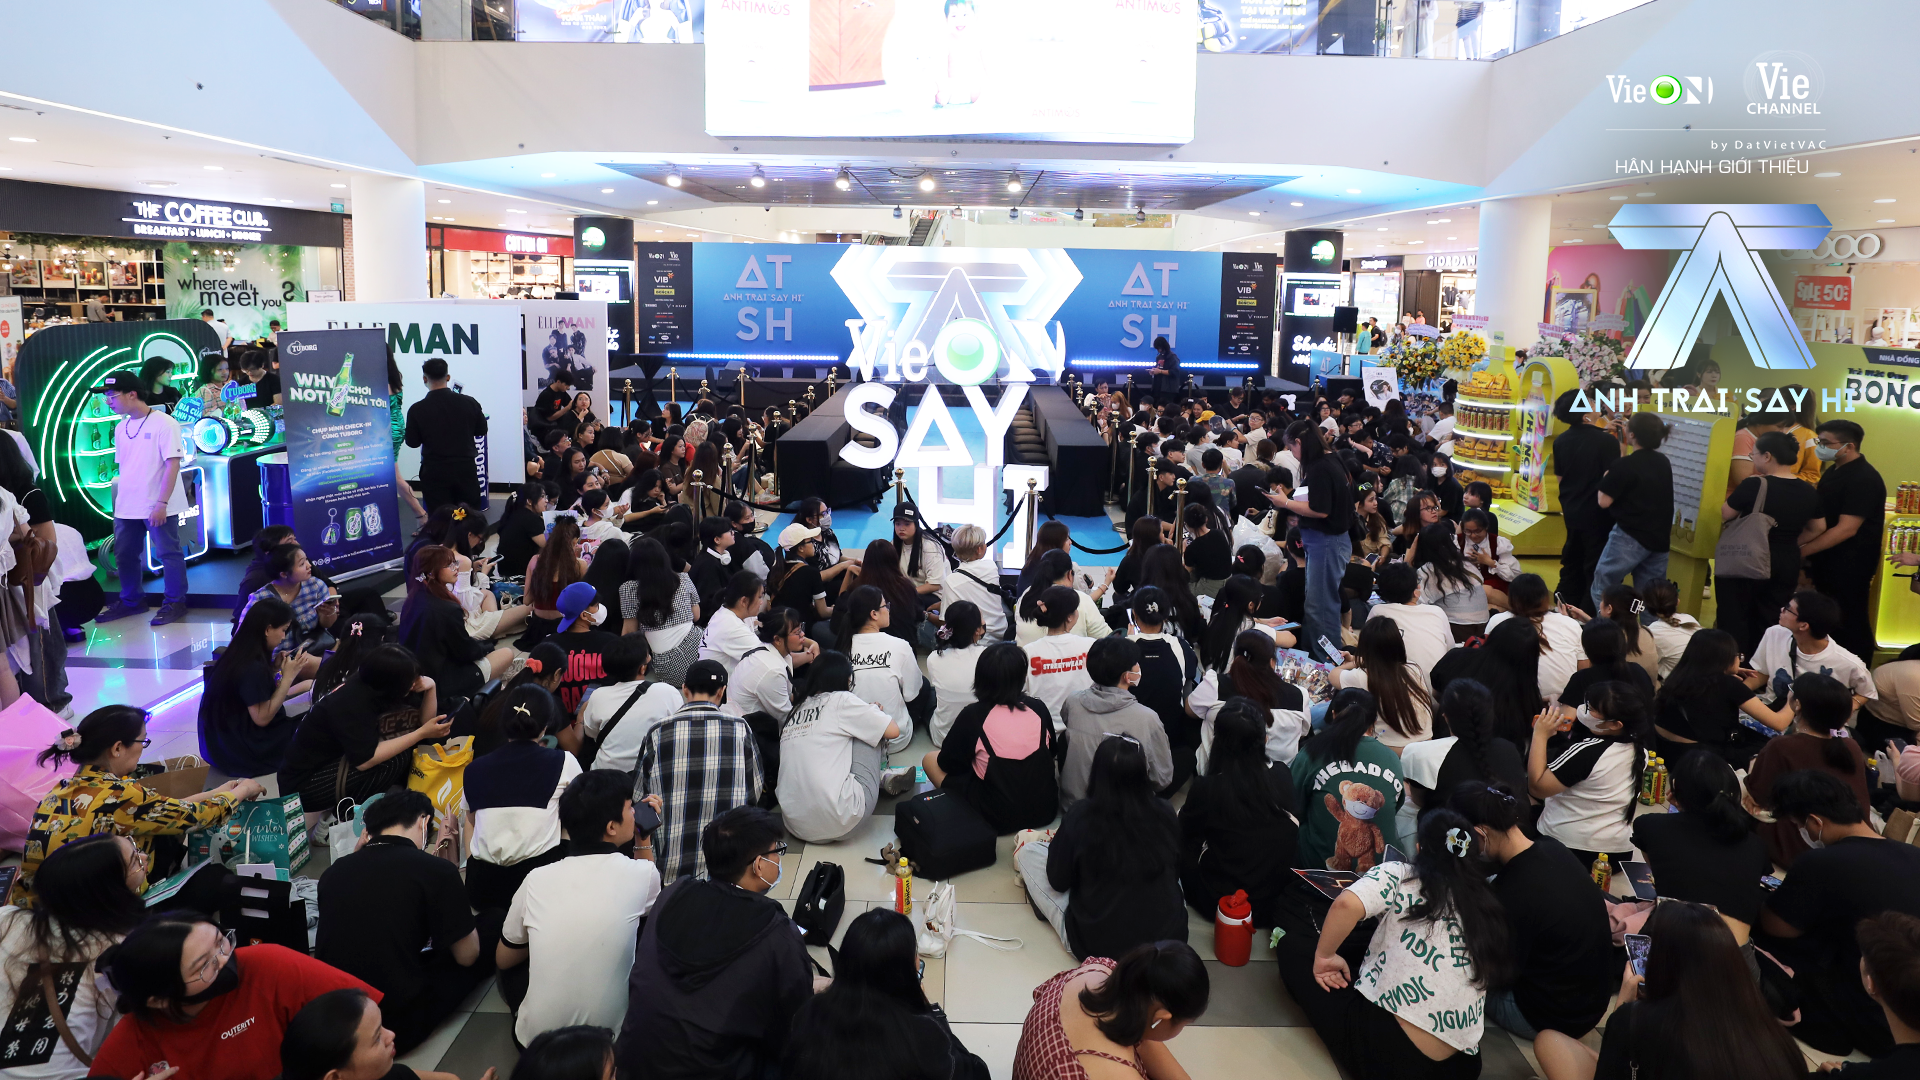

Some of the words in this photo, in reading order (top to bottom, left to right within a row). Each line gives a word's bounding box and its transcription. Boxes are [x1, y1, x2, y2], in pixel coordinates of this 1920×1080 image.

[133, 201, 162, 218] THE
[164, 202, 232, 226] COFFEE
[134, 224, 190, 237] BREAKFAST
[196, 228, 226, 239] LUNCH
[232, 231, 262, 241] DINNER
[177, 272, 228, 291] where
[230, 280, 248, 291] will
[200, 287, 259, 306] meet
[262, 299, 282, 311] you
[723, 292, 742, 300] ANH
[745, 293, 766, 301] TRAI
[1130, 300, 1152, 308] TRAI
[736, 306, 792, 341] SH
[1120, 313, 1177, 348] SH
[388, 322, 479, 355] MAN
[292, 344, 318, 353] TUBORG
[294, 372, 336, 388] WHY
[227, 384, 256, 398] TUBORG
[290, 387, 330, 403] NOT!
[348, 386, 372, 396] CHƠI
[839, 382, 1030, 470] SAY
[918, 463, 1050, 569] HI
[1313, 761, 1340, 790] THE
[220, 1016, 255, 1040] OUTERITY
